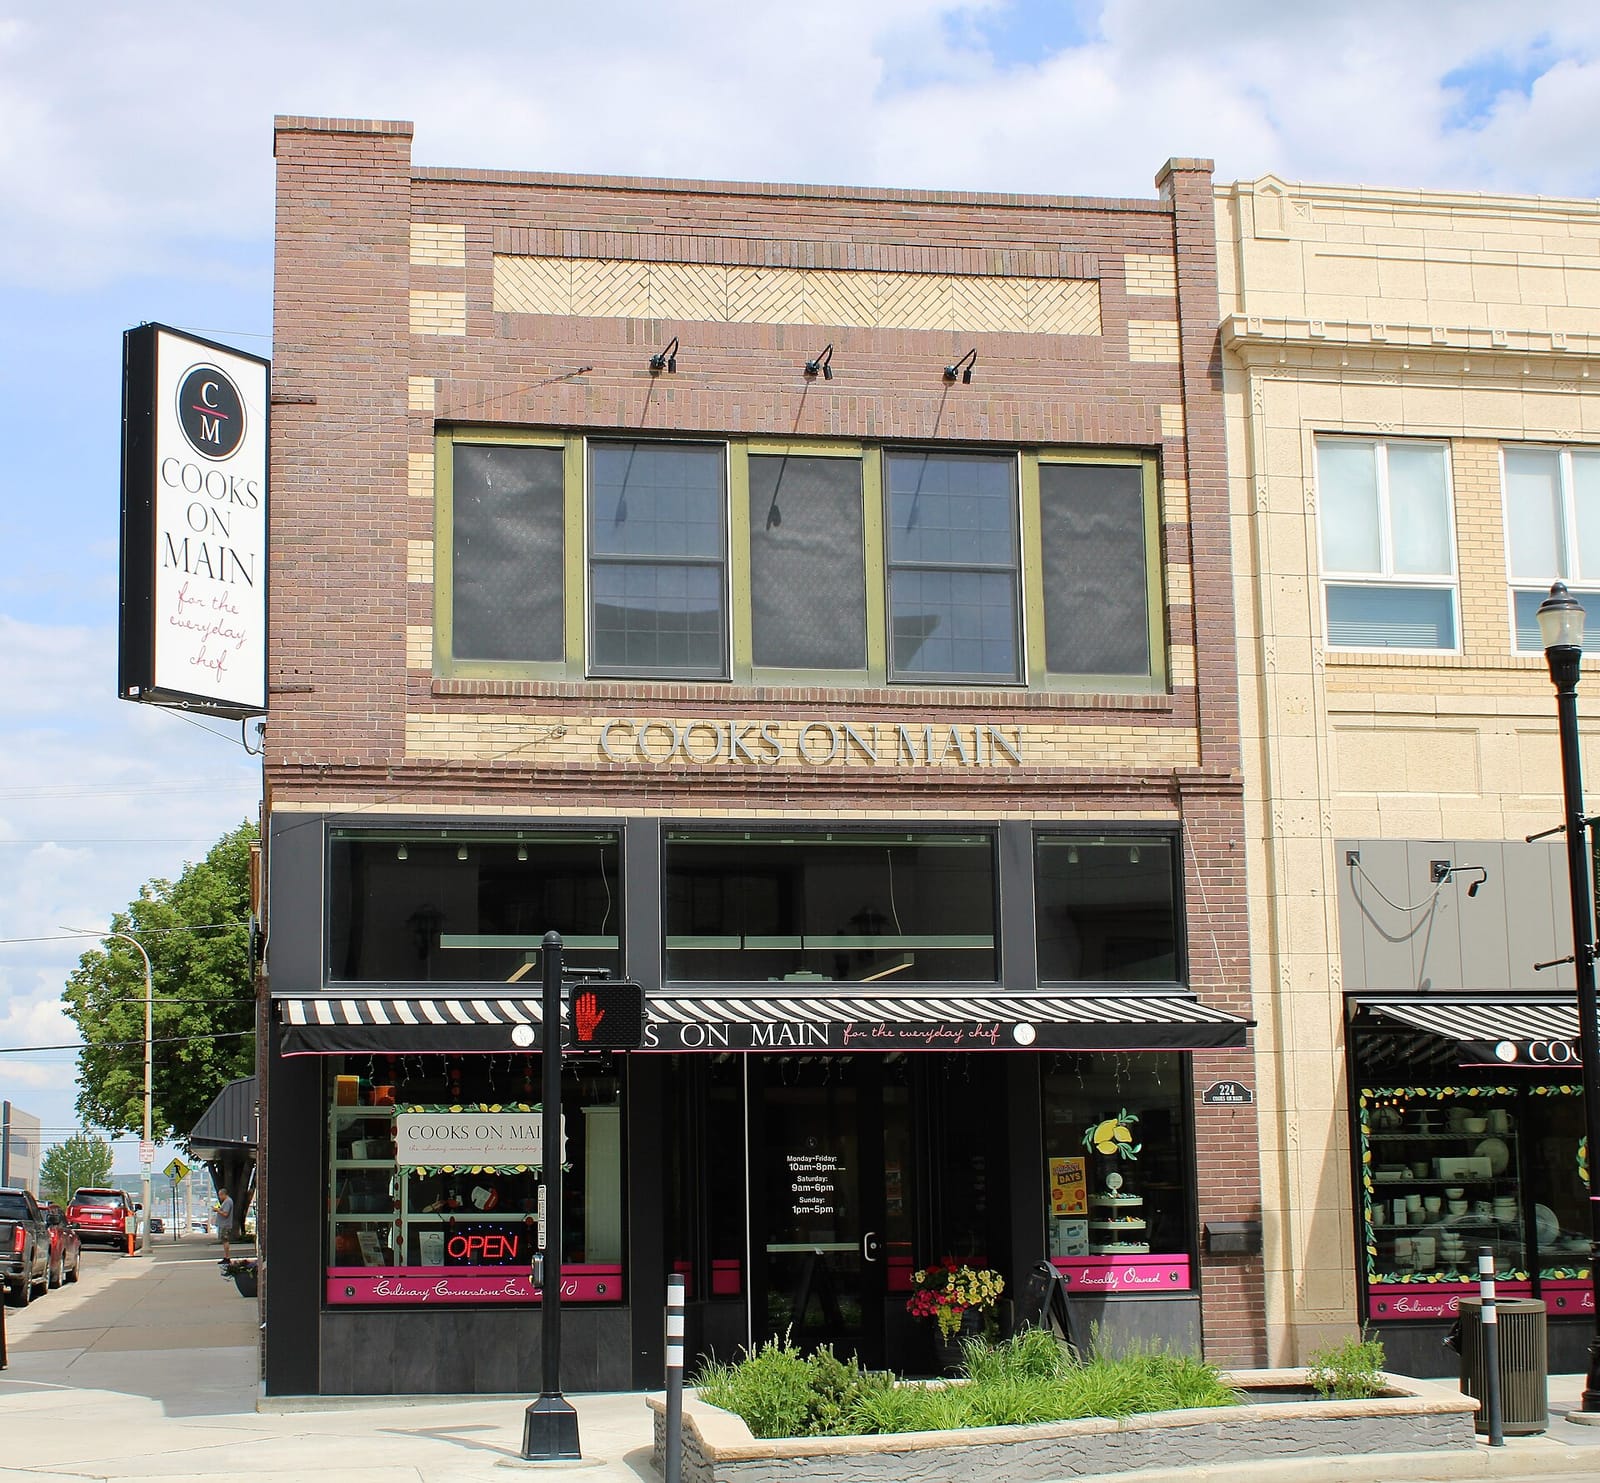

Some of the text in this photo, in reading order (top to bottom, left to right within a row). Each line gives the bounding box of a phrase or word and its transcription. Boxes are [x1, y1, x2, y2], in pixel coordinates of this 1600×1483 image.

[201, 381, 219, 408] C
[200, 414, 221, 444] M
[161, 457, 258, 510] COOKS
[186, 502, 231, 539] ON
[163, 531, 256, 588] MAIN
[178, 581, 239, 615] for the
[169, 615, 247, 650] everyday
[189, 645, 228, 683] chef
[600, 718, 1024, 765] COOKS ON MAIN
[679, 1023, 730, 1048] ON
[750, 1022, 832, 1047] MAIN
[843, 1023, 867, 1046] for
[871, 1023, 895, 1038] the
[899, 1024, 964, 1044] everyday
[968, 1023, 1001, 1046] chef
[1219, 1084, 1235, 1096] 224
[408, 1125, 542, 1140] COOKS ON MAI
[786, 1155, 838, 1163] Monday-Friday:
[788, 1163, 836, 1172] 10am-8pm
[791, 1184, 834, 1193] 9am-6pm
[796, 1175, 829, 1183] Saturday:
[1059, 1172, 1081, 1184] DAYS
[791, 1205, 834, 1215] 1pm-5pm
[799, 1196, 826, 1204] Sunday:
[447, 1235, 519, 1259] OPEN
[1080, 1268, 1120, 1289] Locally
[1123, 1267, 1160, 1284] Owned
[373, 1280, 430, 1301] Culinary
[432, 1280, 500, 1297] Cornerstone
[1393, 1296, 1444, 1316] Culinary
